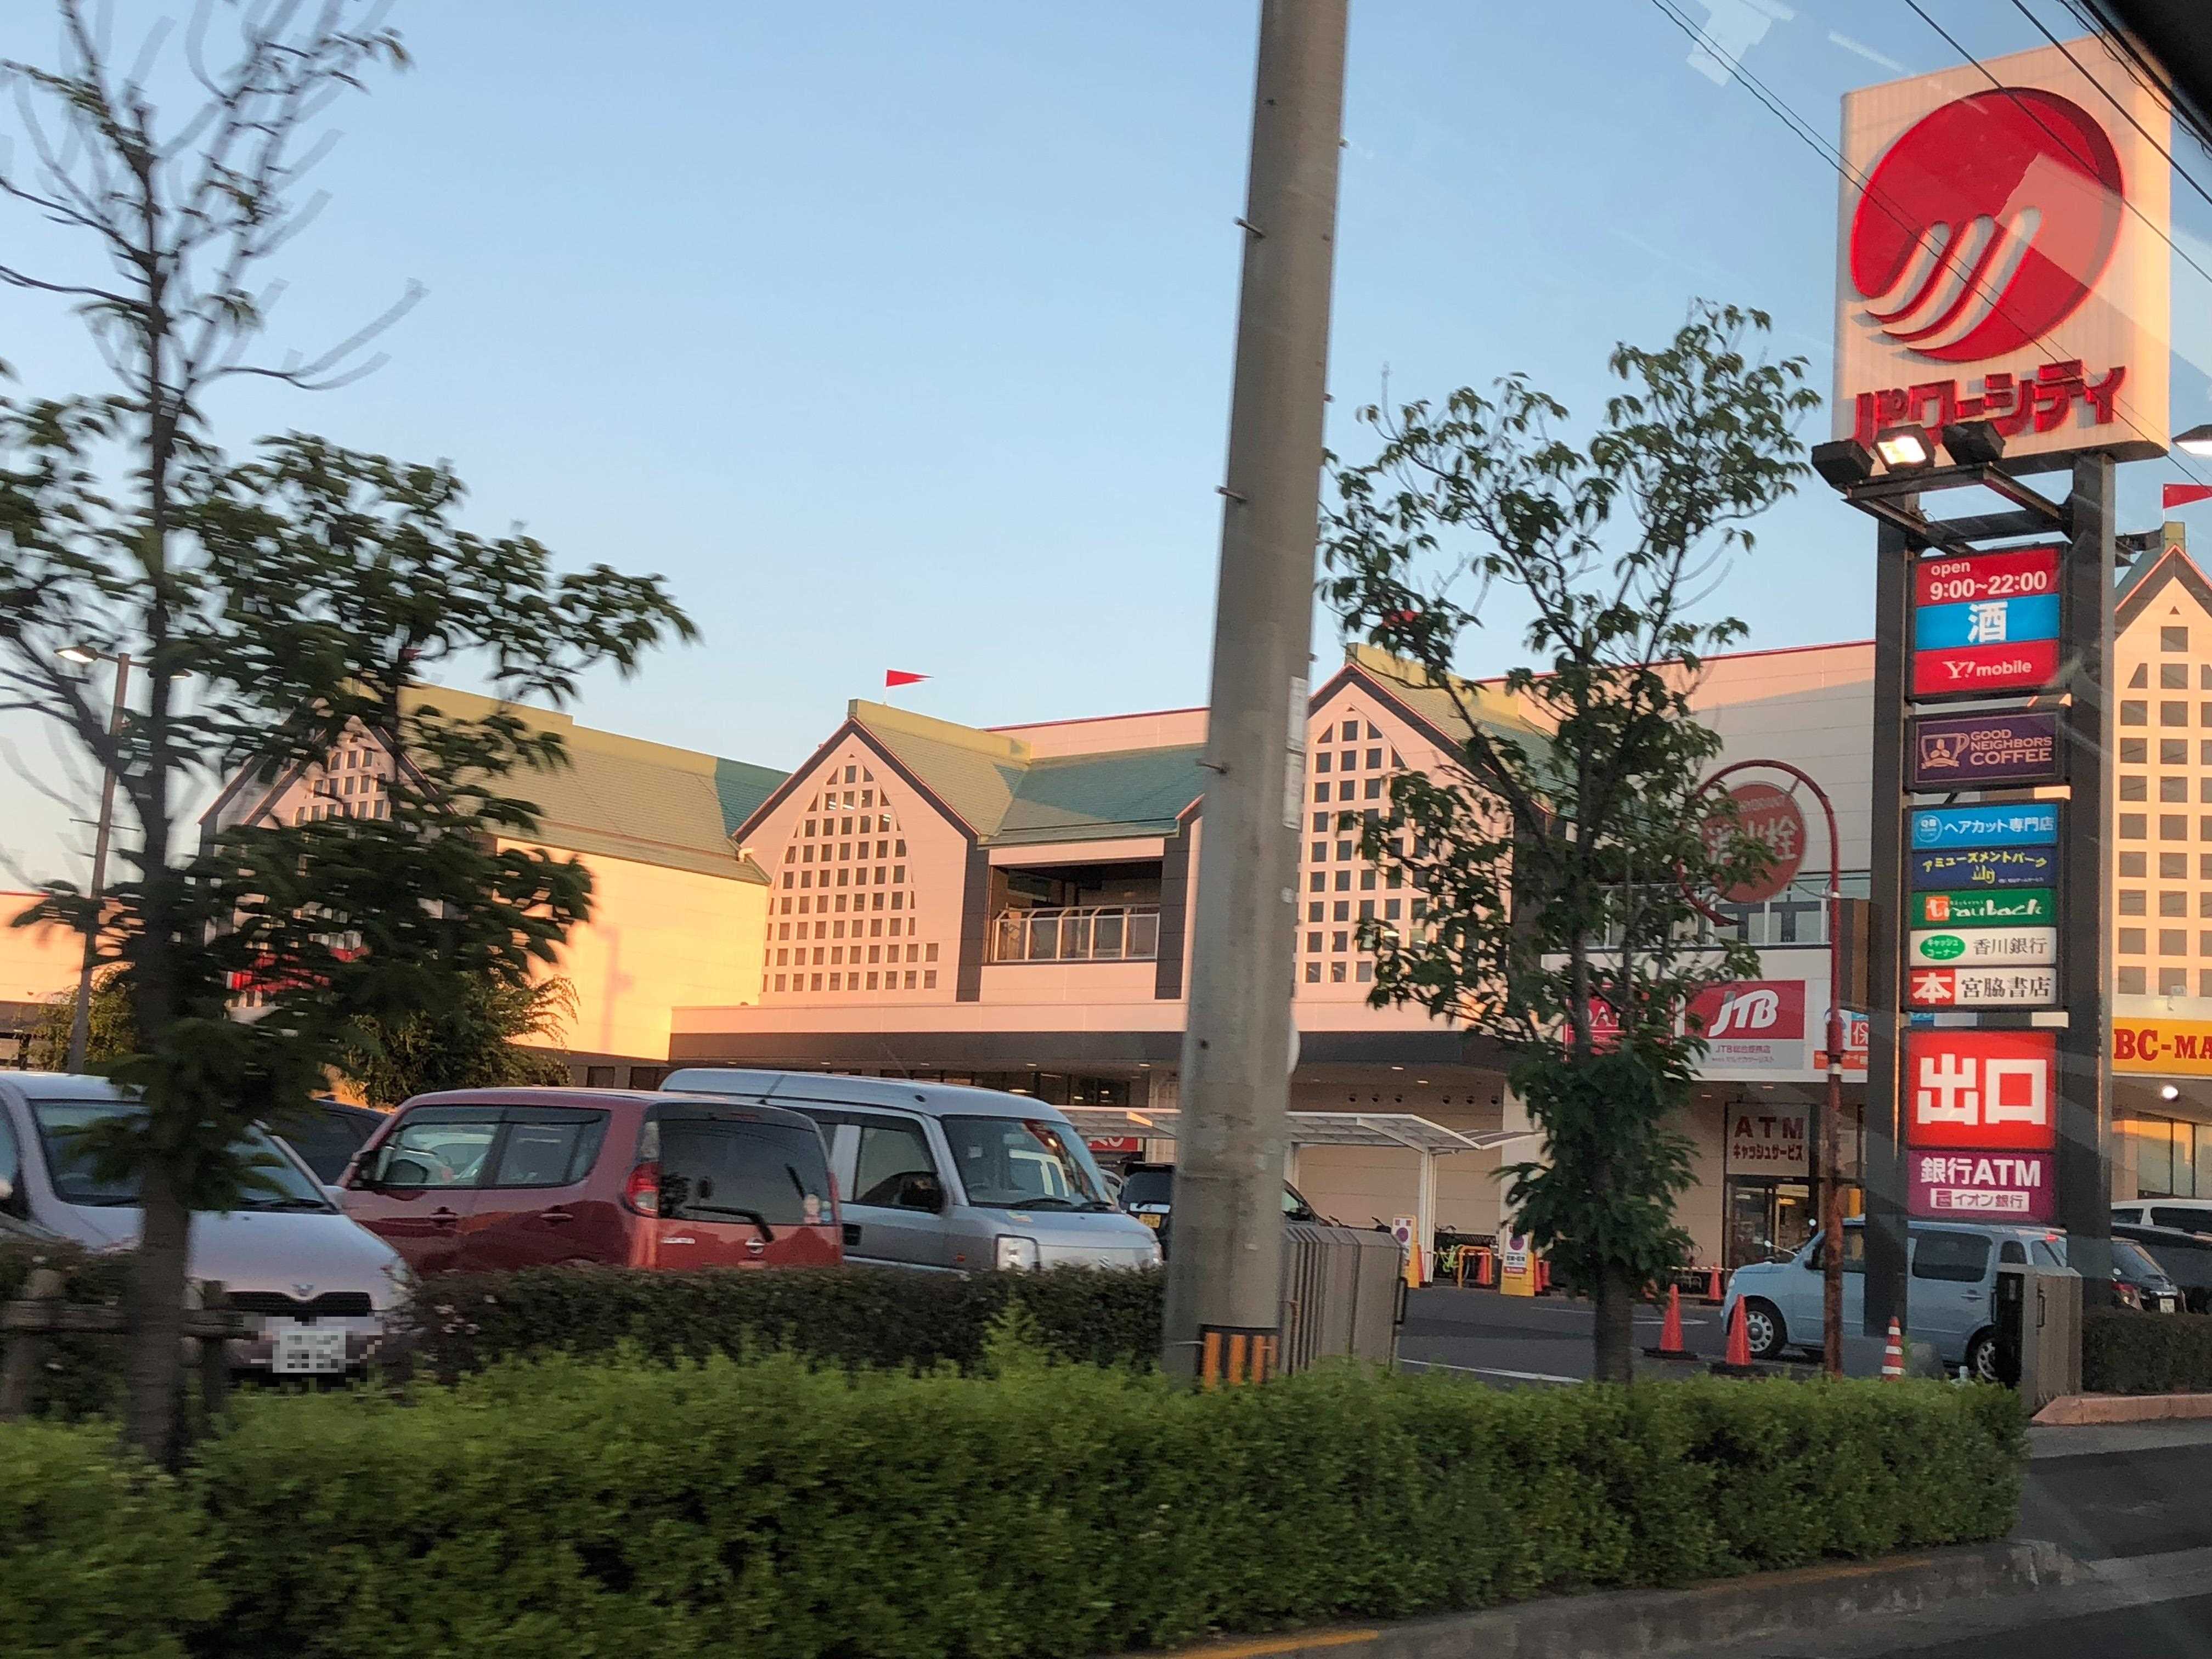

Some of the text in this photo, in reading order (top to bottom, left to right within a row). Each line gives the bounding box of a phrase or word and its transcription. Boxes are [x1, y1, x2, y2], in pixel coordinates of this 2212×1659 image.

[1853, 359, 2126, 449] パワーシティ
[1931, 561, 1971, 578] open
[1968, 600, 2008, 642] 酒
[1970, 736, 2052, 751] NEIGHBORS
[1971, 729, 2012, 741] GOOD
[1970, 748, 2052, 765] COFFEE
[1944, 816, 2055, 834] ヘアカット専門店
[1973, 937, 2047, 955] 香川銀行
[1912, 972, 2052, 1004] 本 宮脇書店
[1708, 989, 1779, 1037] JTB
[1917, 1053, 2047, 1126] 出口
[1734, 1115, 1804, 1139] ATM
[1733, 1143, 1804, 1161] キャッシュサービス
[1920, 1156, 2041, 1187] 銀行ATM
[1955, 1193, 2024, 1209] イオン銀行
